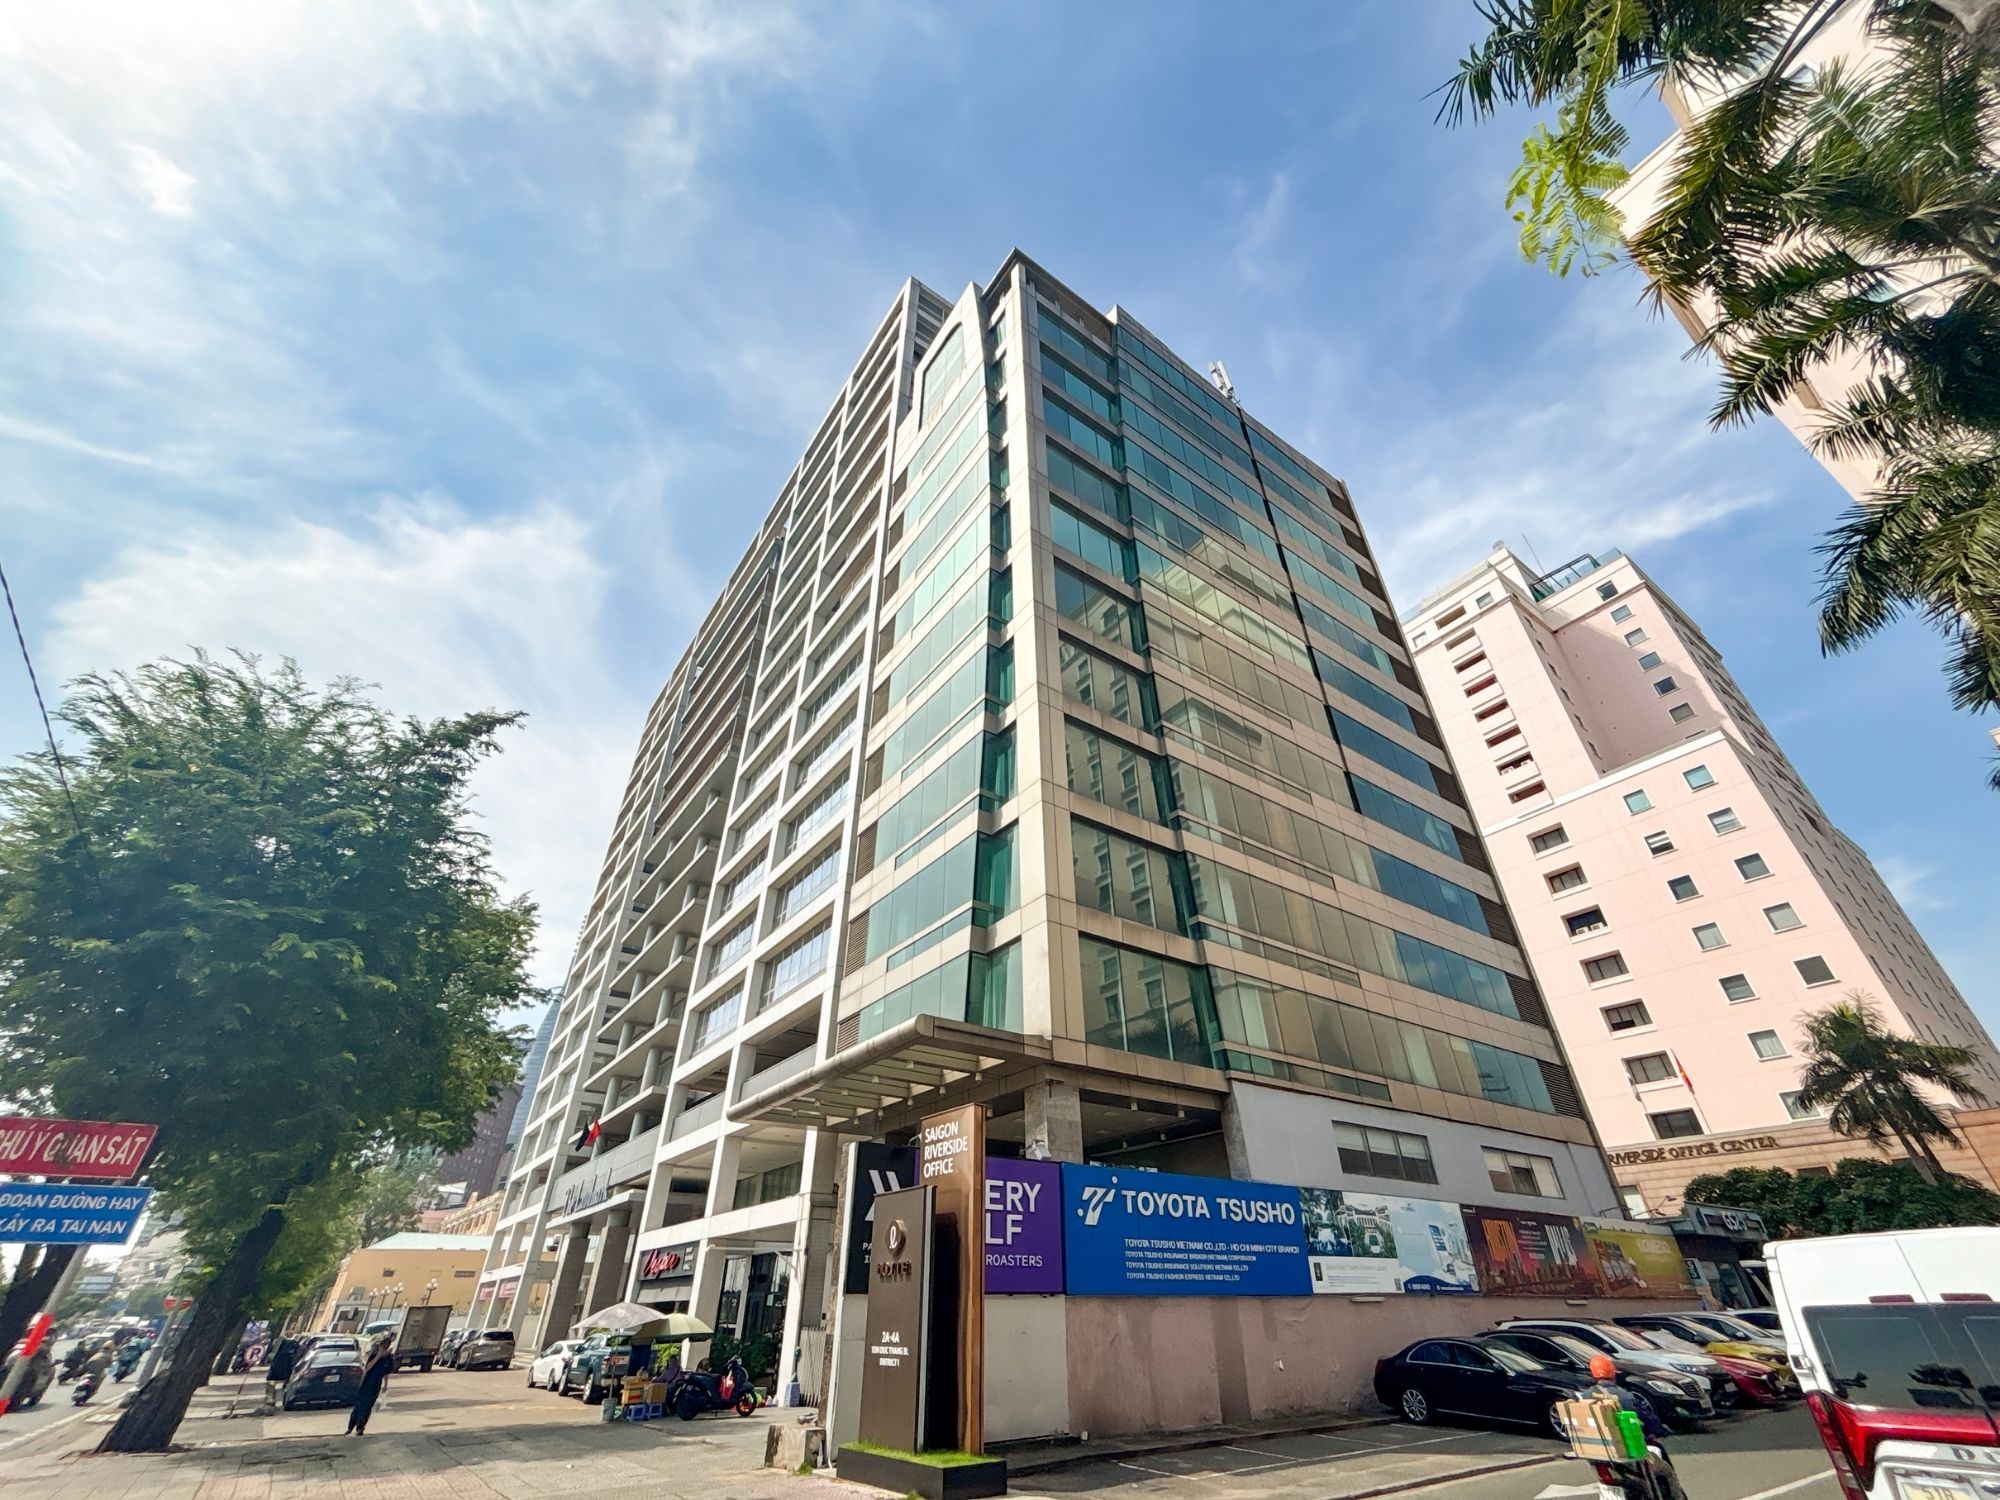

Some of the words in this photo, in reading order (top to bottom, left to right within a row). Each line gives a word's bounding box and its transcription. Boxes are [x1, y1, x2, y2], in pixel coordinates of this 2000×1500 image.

[925, 1120, 959, 1143] SAIGON
[28, 1124, 56, 1160] Ý
[99, 1129, 147, 1165] SÁT
[924, 1136, 968, 1160] RIVERSIDE
[1607, 1147, 1667, 1165] RIVERSIDE
[1668, 1142, 1718, 1160] OFFICE
[1720, 1136, 1779, 1153] CENTER
[923, 1157, 954, 1178] OFFICE
[48, 1191, 108, 1209] ĐƯỜNG
[108, 1196, 143, 1210] HAY
[985, 1179, 1041, 1213] ERY
[1121, 1189, 1211, 1219] TOYOTA
[1216, 1197, 1296, 1226] TSUSHO
[30, 1218, 56, 1233] RA
[60, 1219, 88, 1233] TAI
[985, 1212, 1023, 1245] LF
[1124, 1238, 1150, 1248] TOYOTA
[1150, 1240, 1176, 1249] TSUSHO
[1176, 1241, 1203, 1250] VIETNAM
[1230, 1243, 1240, 1251] HO
[1250, 1244, 1265, 1252] MINH
[1265, 1245, 1277, 1253] CITY
[1277, 1245, 1300, 1254] BRANCH
[1125, 1250, 1144, 1258] TOYOTA
[1144, 1251, 1163, 1259] TSUSHO
[1163, 1252, 1188, 1260] INSURANCE
[985, 1254, 1043, 1267] ROASTERS
[1125, 1261, 1145, 1269] TOYOTA
[1145, 1262, 1163, 1270] TSUSHO
[1164, 1262, 1189, 1270] INSURANCE
[881, 1331, 900, 1343] 2A-4A
